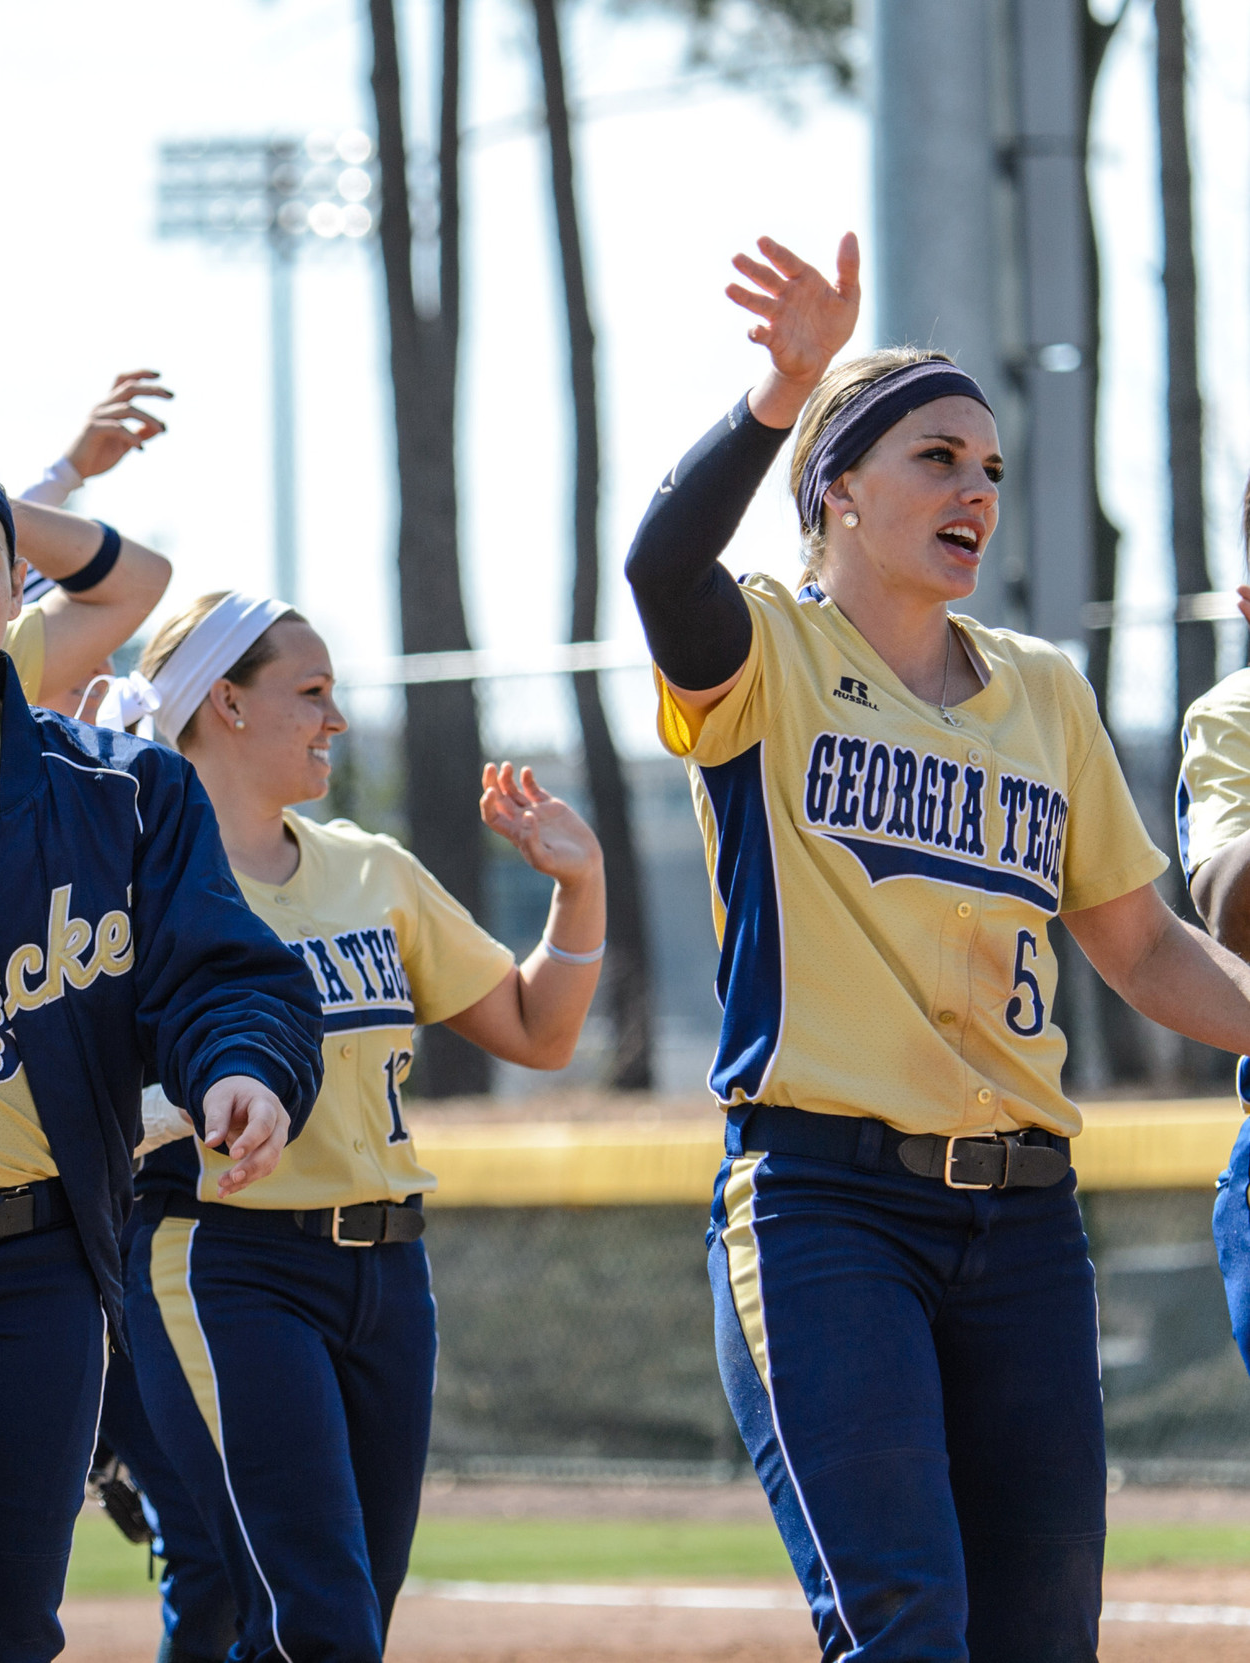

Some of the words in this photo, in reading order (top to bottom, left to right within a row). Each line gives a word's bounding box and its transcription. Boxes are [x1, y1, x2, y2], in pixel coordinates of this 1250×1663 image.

[832, 688, 880, 711] RUSSELL
[804, 731, 987, 858] GEORGIA
[998, 773, 1069, 889] TECH
[4, 881, 136, 1021] cke
[333, 926, 412, 1003] TEC
[1003, 927, 1046, 1038] 5
